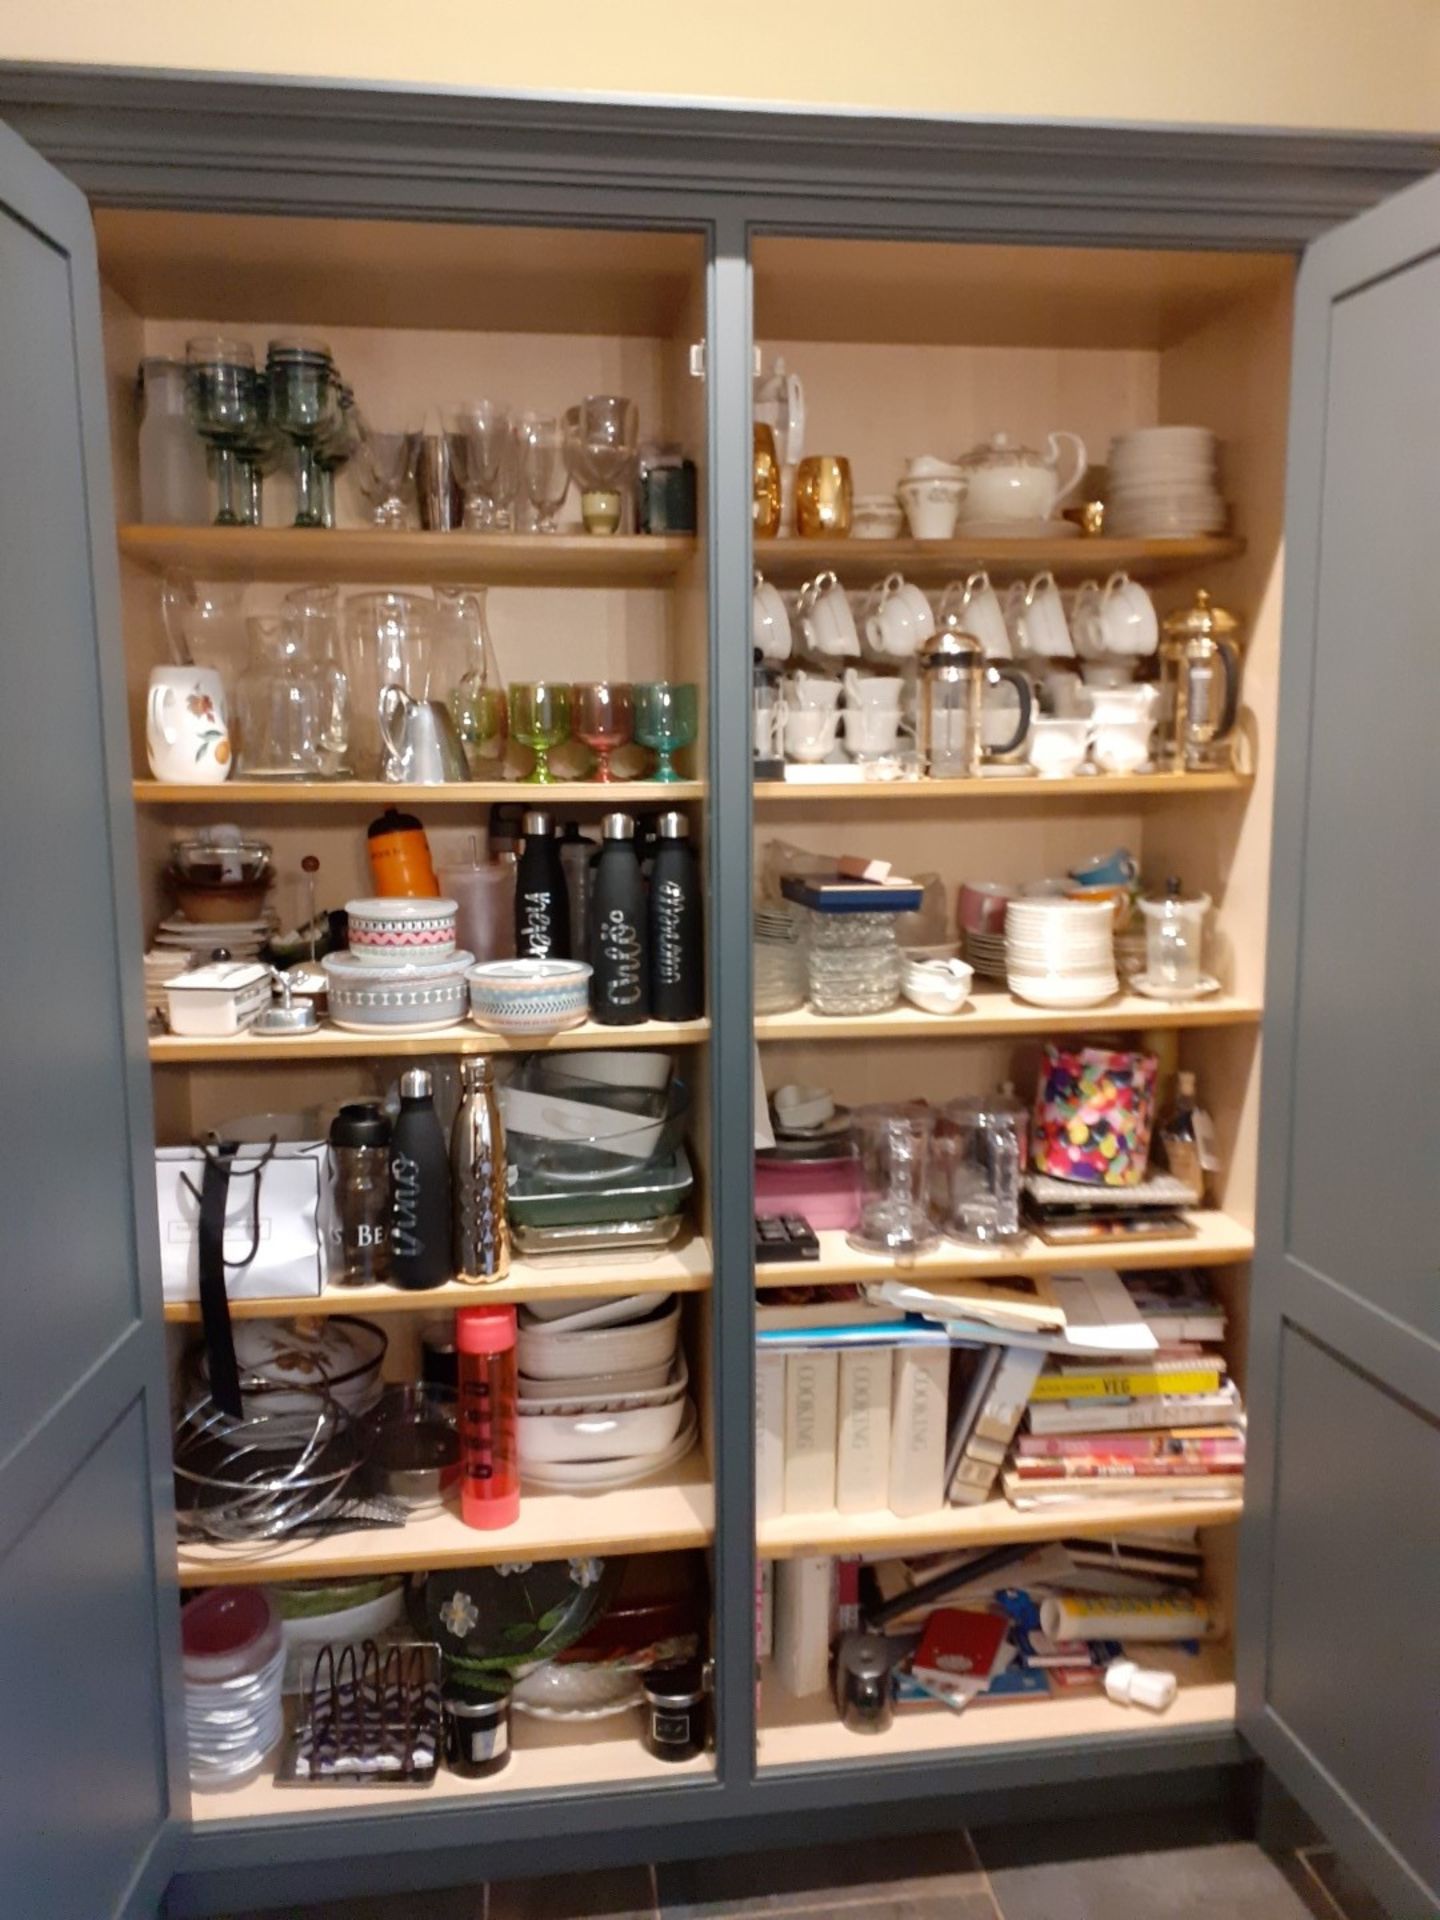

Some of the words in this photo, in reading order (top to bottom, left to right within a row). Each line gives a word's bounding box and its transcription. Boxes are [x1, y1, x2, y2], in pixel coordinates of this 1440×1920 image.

[796, 1365, 816, 1450] COOKING
[851, 1365, 872, 1450] COOKING
[911, 1367, 930, 1452] COOKING
